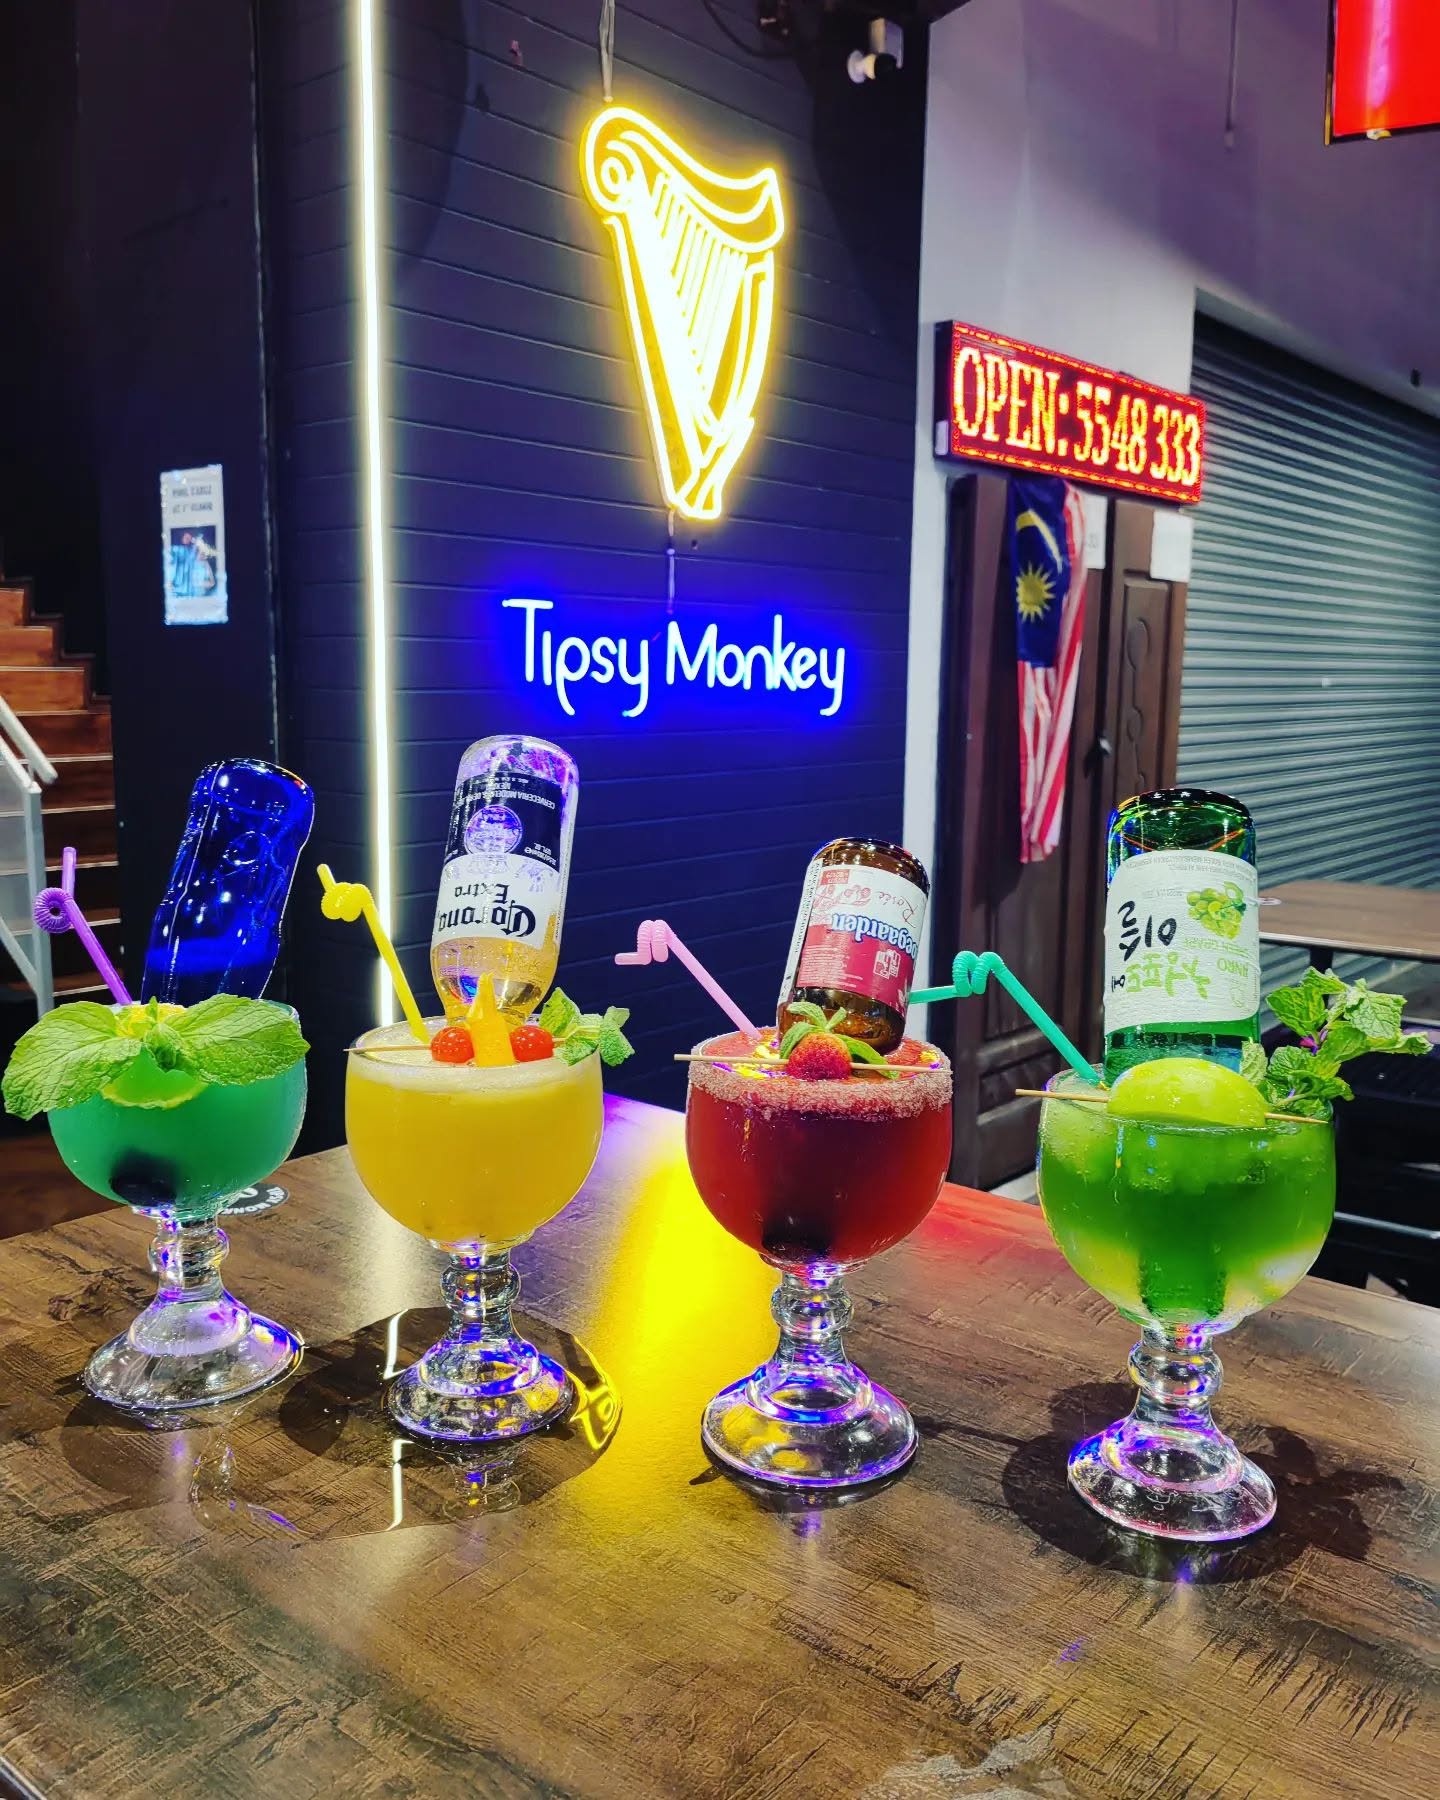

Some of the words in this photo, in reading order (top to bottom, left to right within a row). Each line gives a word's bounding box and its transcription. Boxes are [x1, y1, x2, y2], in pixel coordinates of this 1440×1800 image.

[954, 346, 1069, 457] OPEN:
[1073, 381, 1149, 474] 5548
[1150, 404, 1201, 486] 333
[502, 598, 649, 717] Tipsy
[666, 614, 846, 716] Monkey
[438, 899, 536, 938] Corona
[454, 882, 509, 905] Extra
